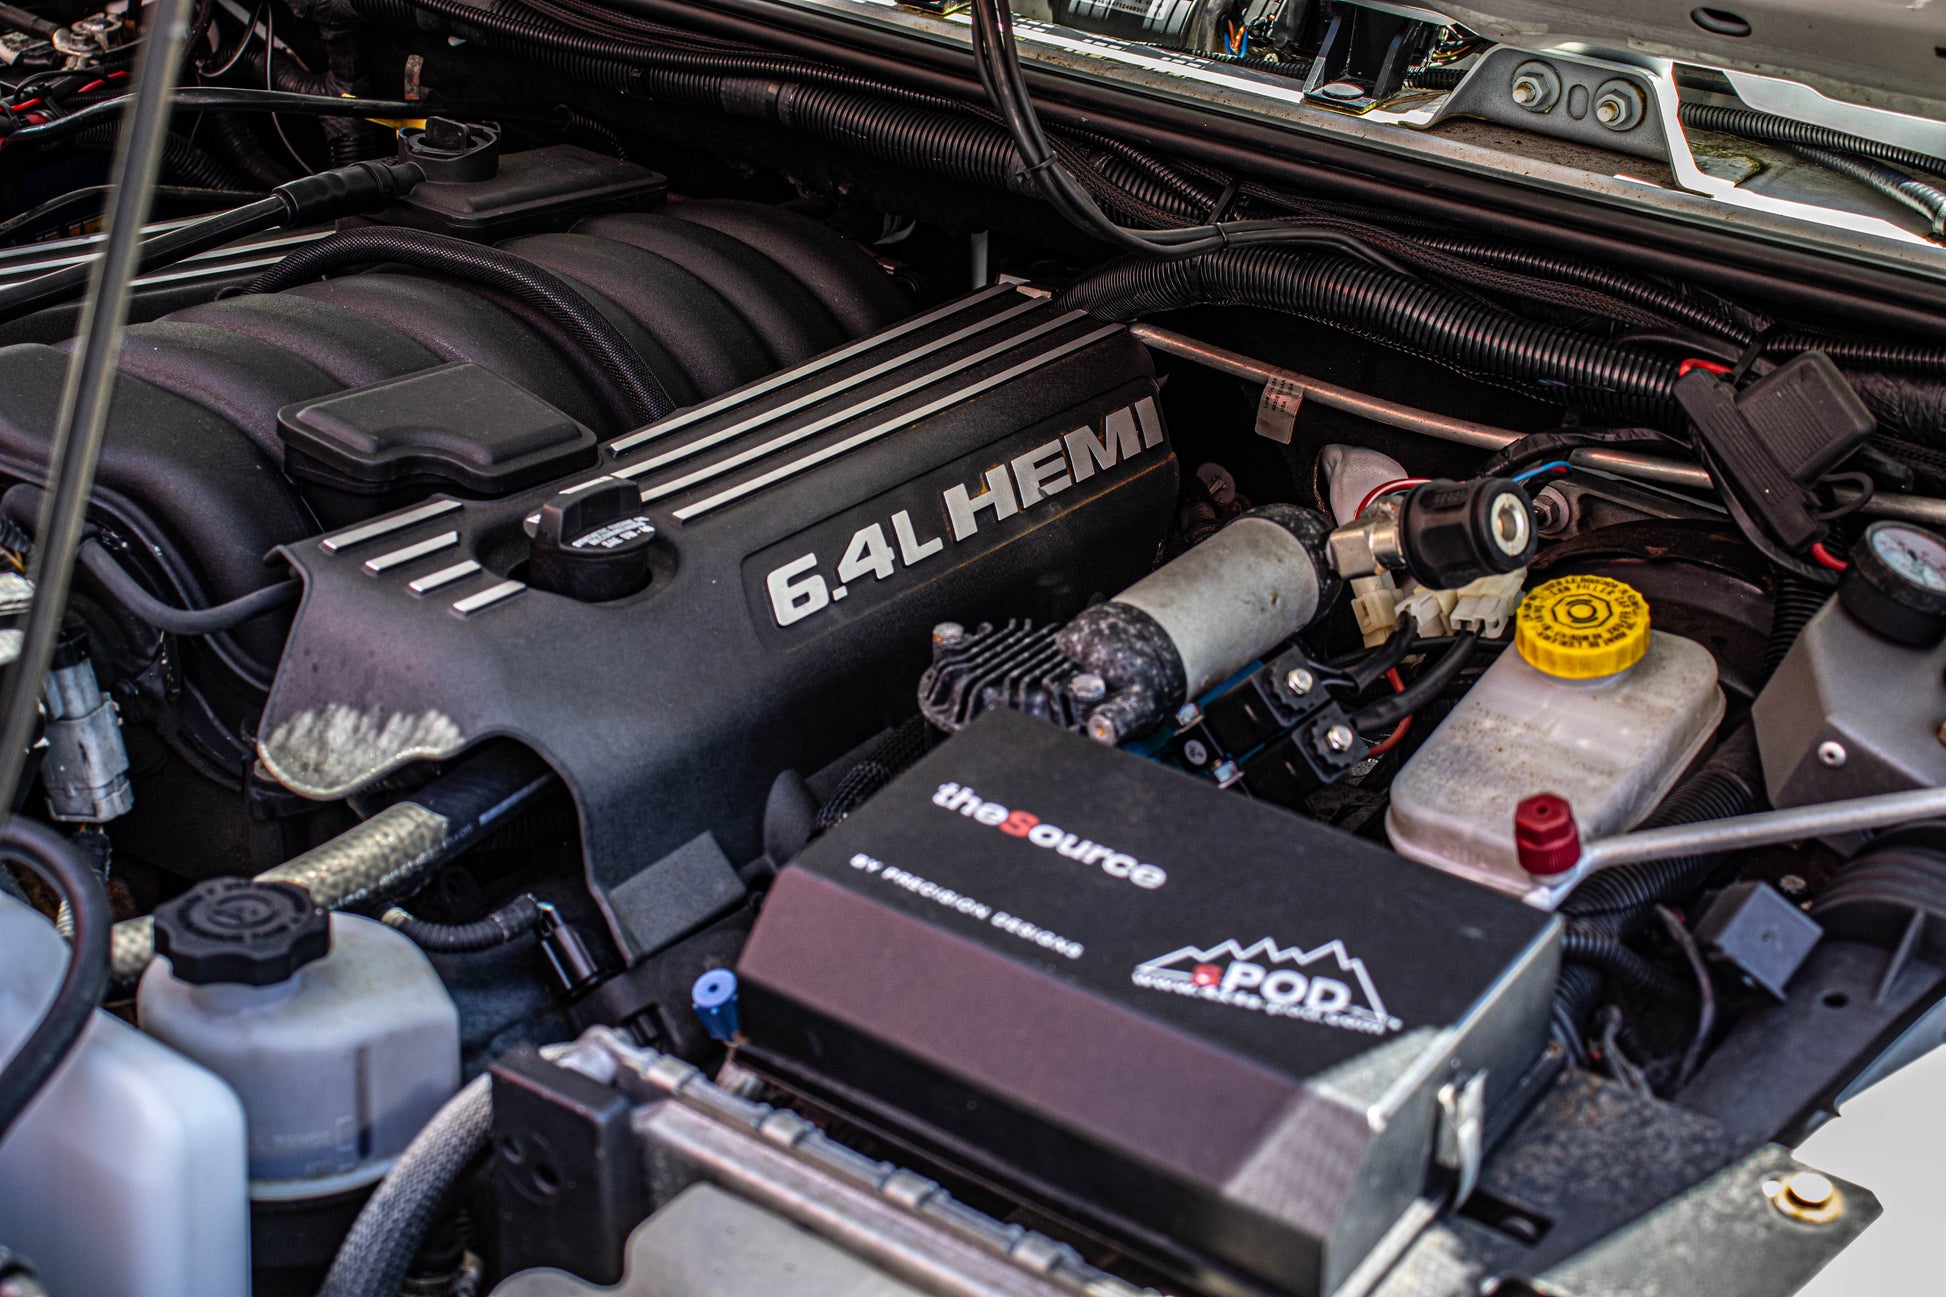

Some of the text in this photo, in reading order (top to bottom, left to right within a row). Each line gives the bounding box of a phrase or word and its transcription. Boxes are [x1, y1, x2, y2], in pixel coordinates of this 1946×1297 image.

[766, 396, 1164, 627] 6.4L HEMI
[932, 782, 1167, 889] theSource
[850, 853, 1085, 960] BY PRECISION DESIGNS
